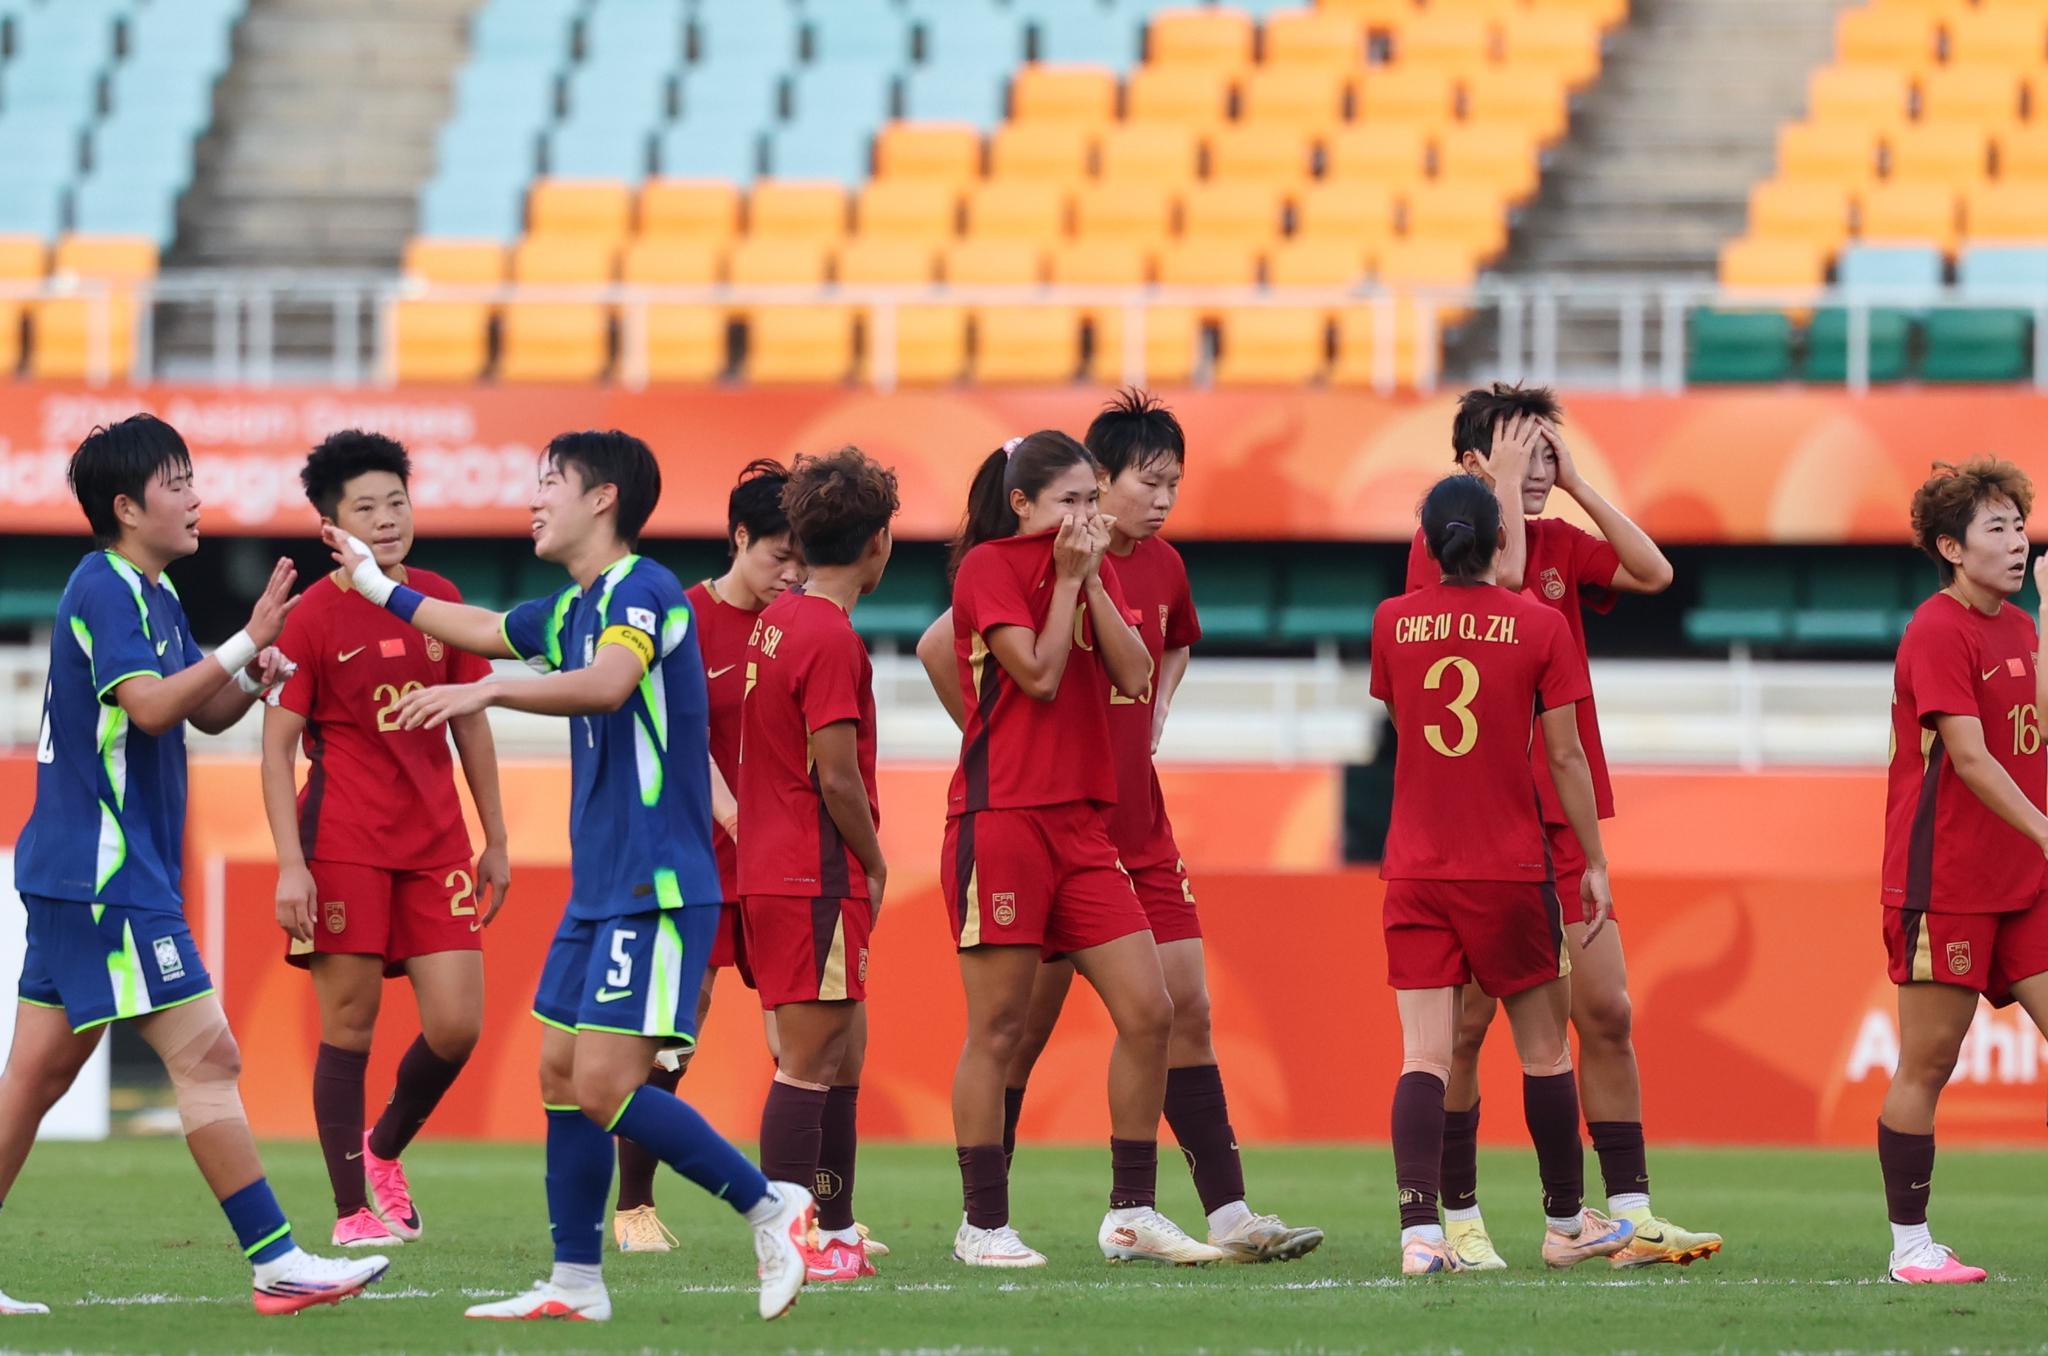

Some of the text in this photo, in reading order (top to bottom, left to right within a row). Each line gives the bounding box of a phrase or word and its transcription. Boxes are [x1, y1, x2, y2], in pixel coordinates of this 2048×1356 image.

[1395, 612, 1520, 645] CHEN Q.ZH.
[1423, 655, 1480, 757] 3
[2007, 703, 2041, 756] 16
[606, 929, 637, 988] 5
